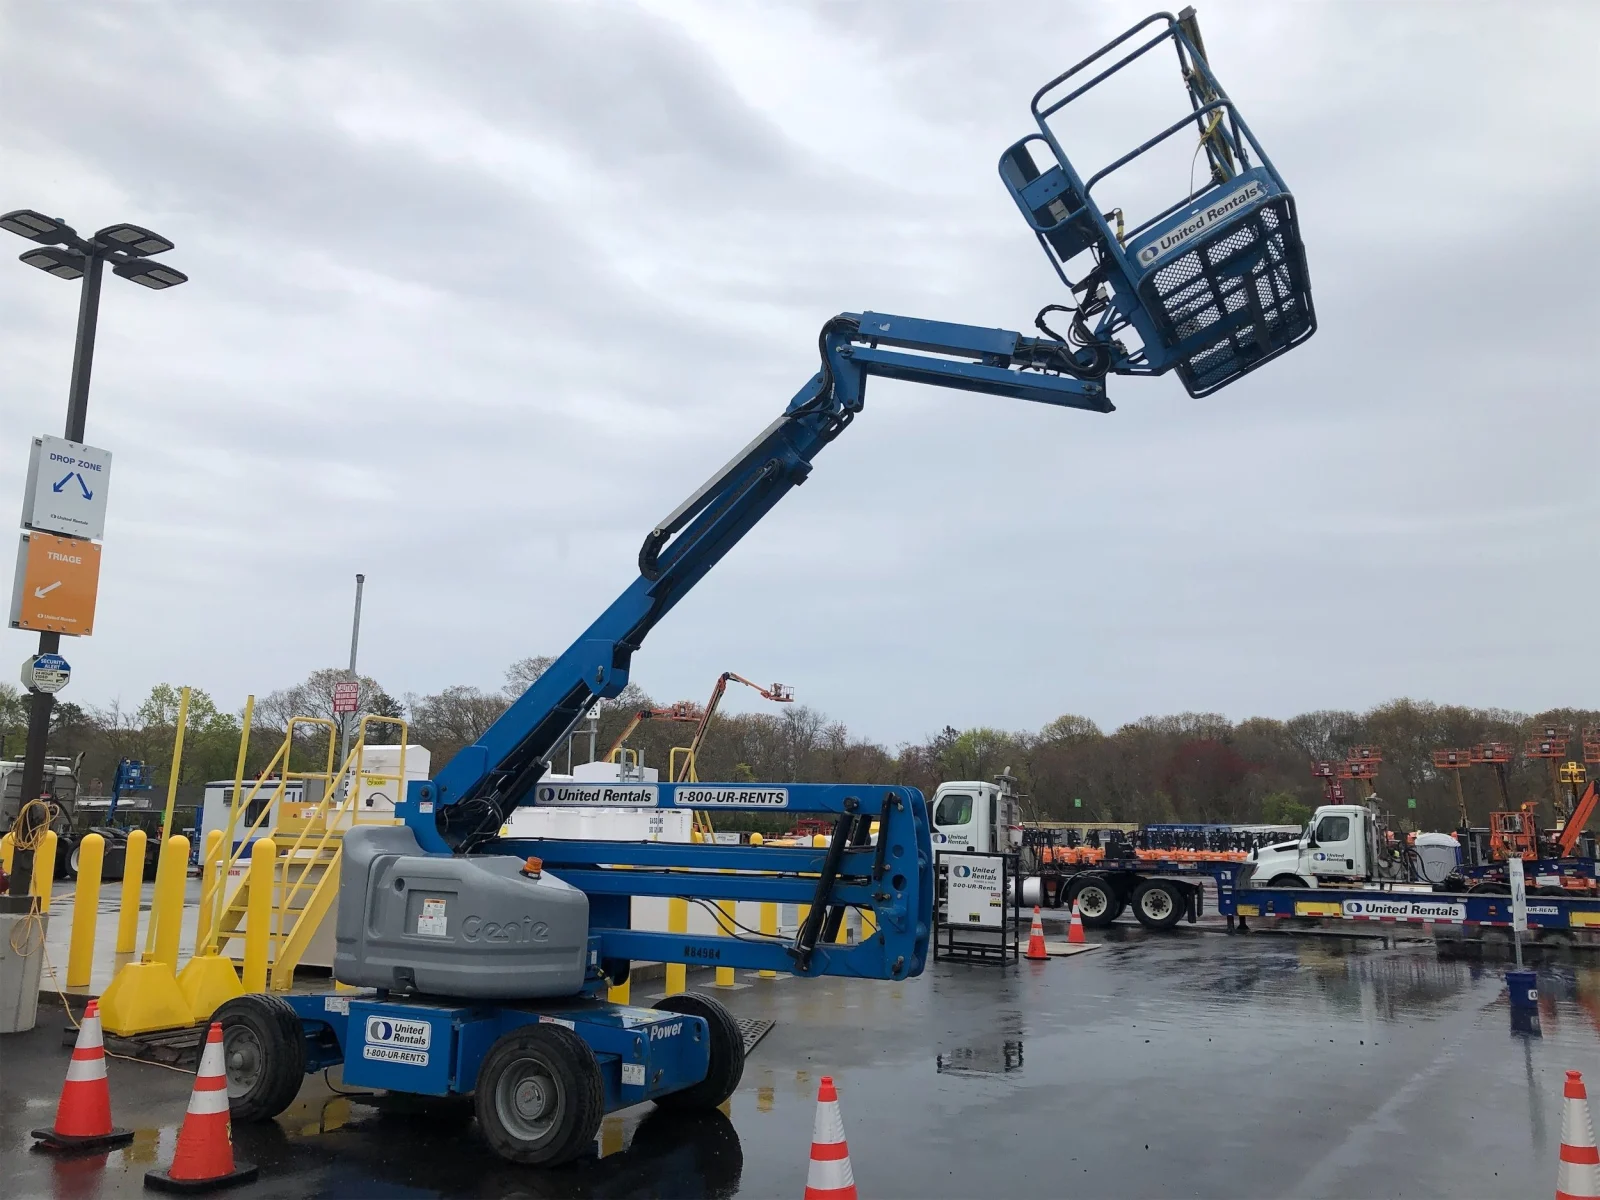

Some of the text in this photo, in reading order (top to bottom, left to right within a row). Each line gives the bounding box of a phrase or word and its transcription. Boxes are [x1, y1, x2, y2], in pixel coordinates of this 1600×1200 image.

[1160, 187, 1257, 250] United Rentals
[49, 453, 102, 472] DROP ZONE
[47, 551, 82, 565] TRIAGE
[40, 658, 65, 666] SECURITY
[557, 788, 651, 802] United Rentals
[678, 791, 785, 804] 1-800-UR-RENTS
[971, 872, 997, 881] Rentals
[972, 866, 996, 874] United
[952, 882, 997, 891] 800-UR-Rents
[1365, 903, 1459, 916] United Rentals
[461, 914, 549, 944] Genie
[394, 1023, 425, 1036] United
[650, 1021, 683, 1041] Power
[393, 1033, 426, 1046] Rentals
[365, 1048, 426, 1063] 1-800-UR-RENTS
